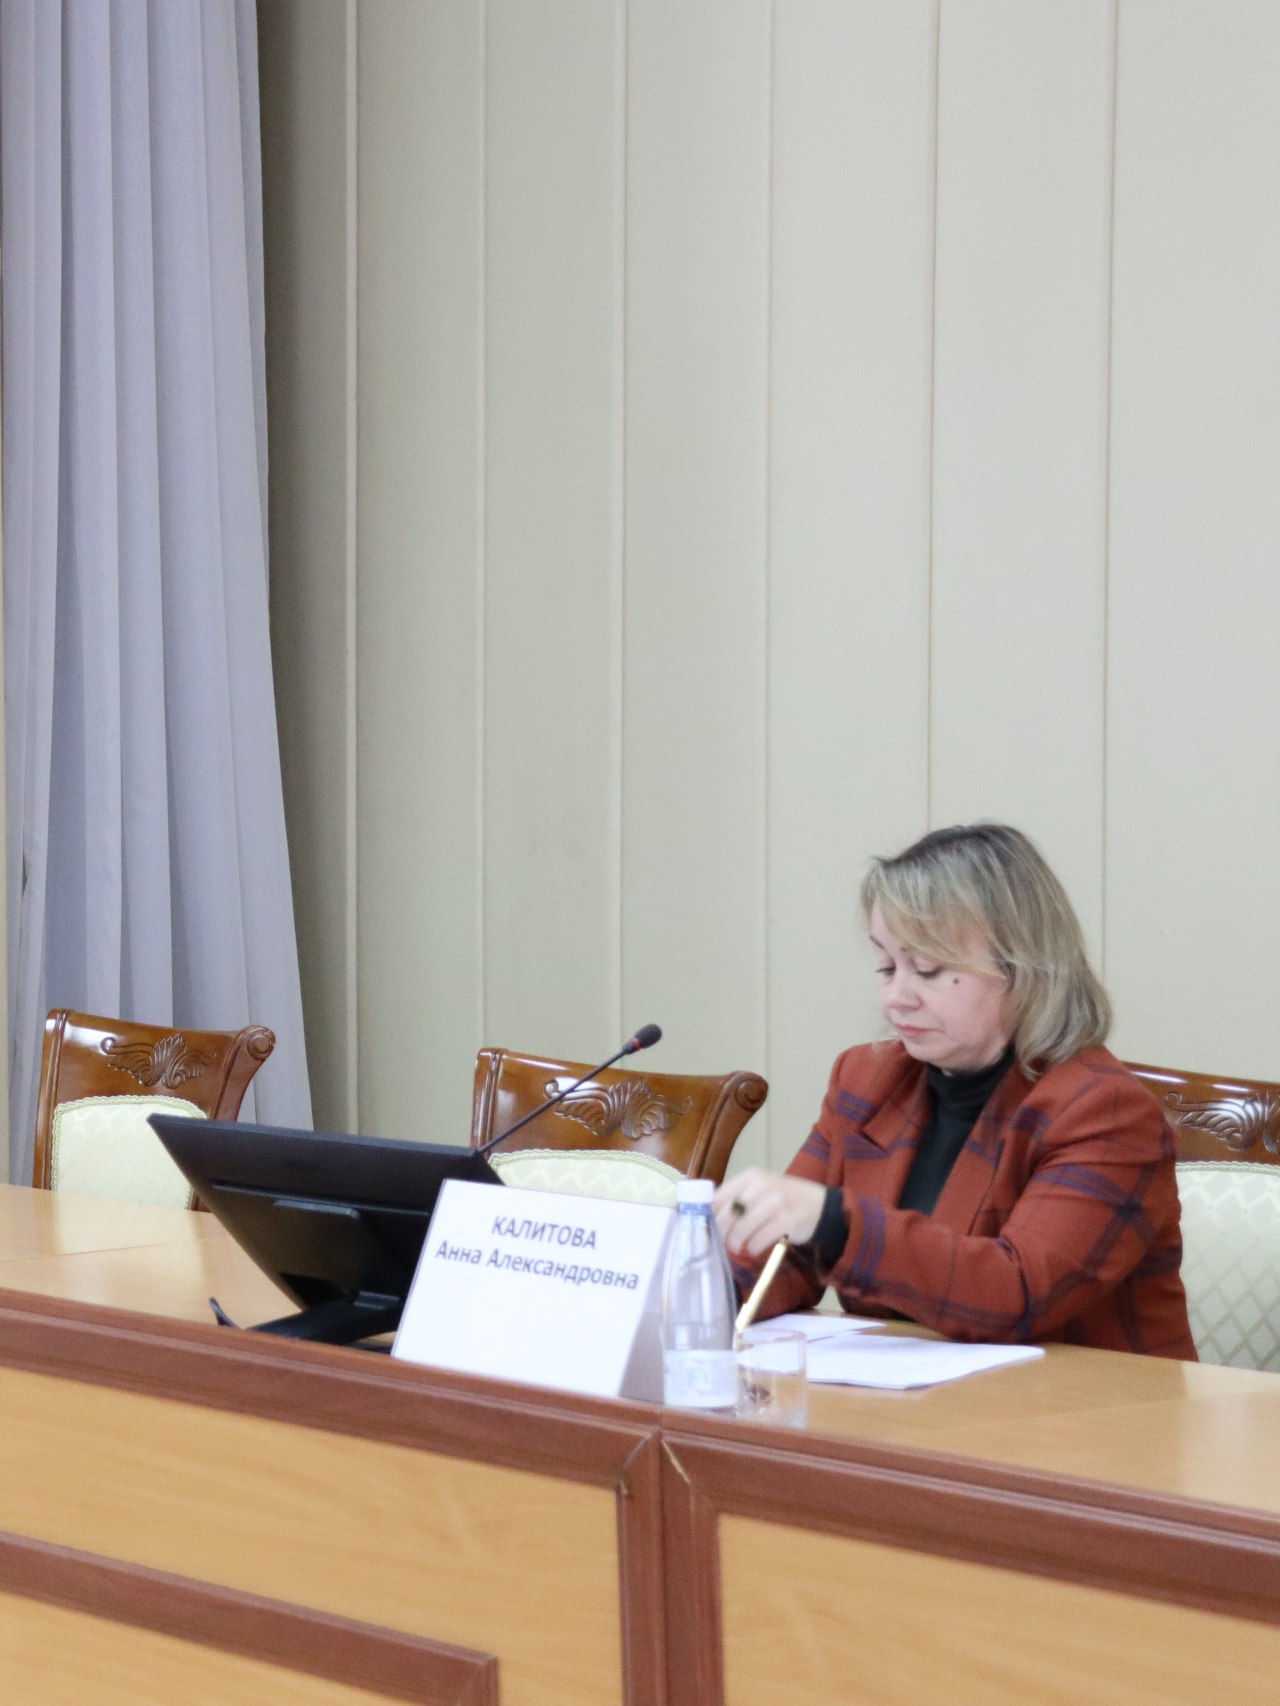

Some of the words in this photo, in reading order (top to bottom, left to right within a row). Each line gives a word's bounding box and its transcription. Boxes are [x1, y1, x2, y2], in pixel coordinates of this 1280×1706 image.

[491, 1215, 597, 1249] КАЛИТОВА
[435, 1239, 482, 1265] Анна
[486, 1248, 639, 1290] Александровна
